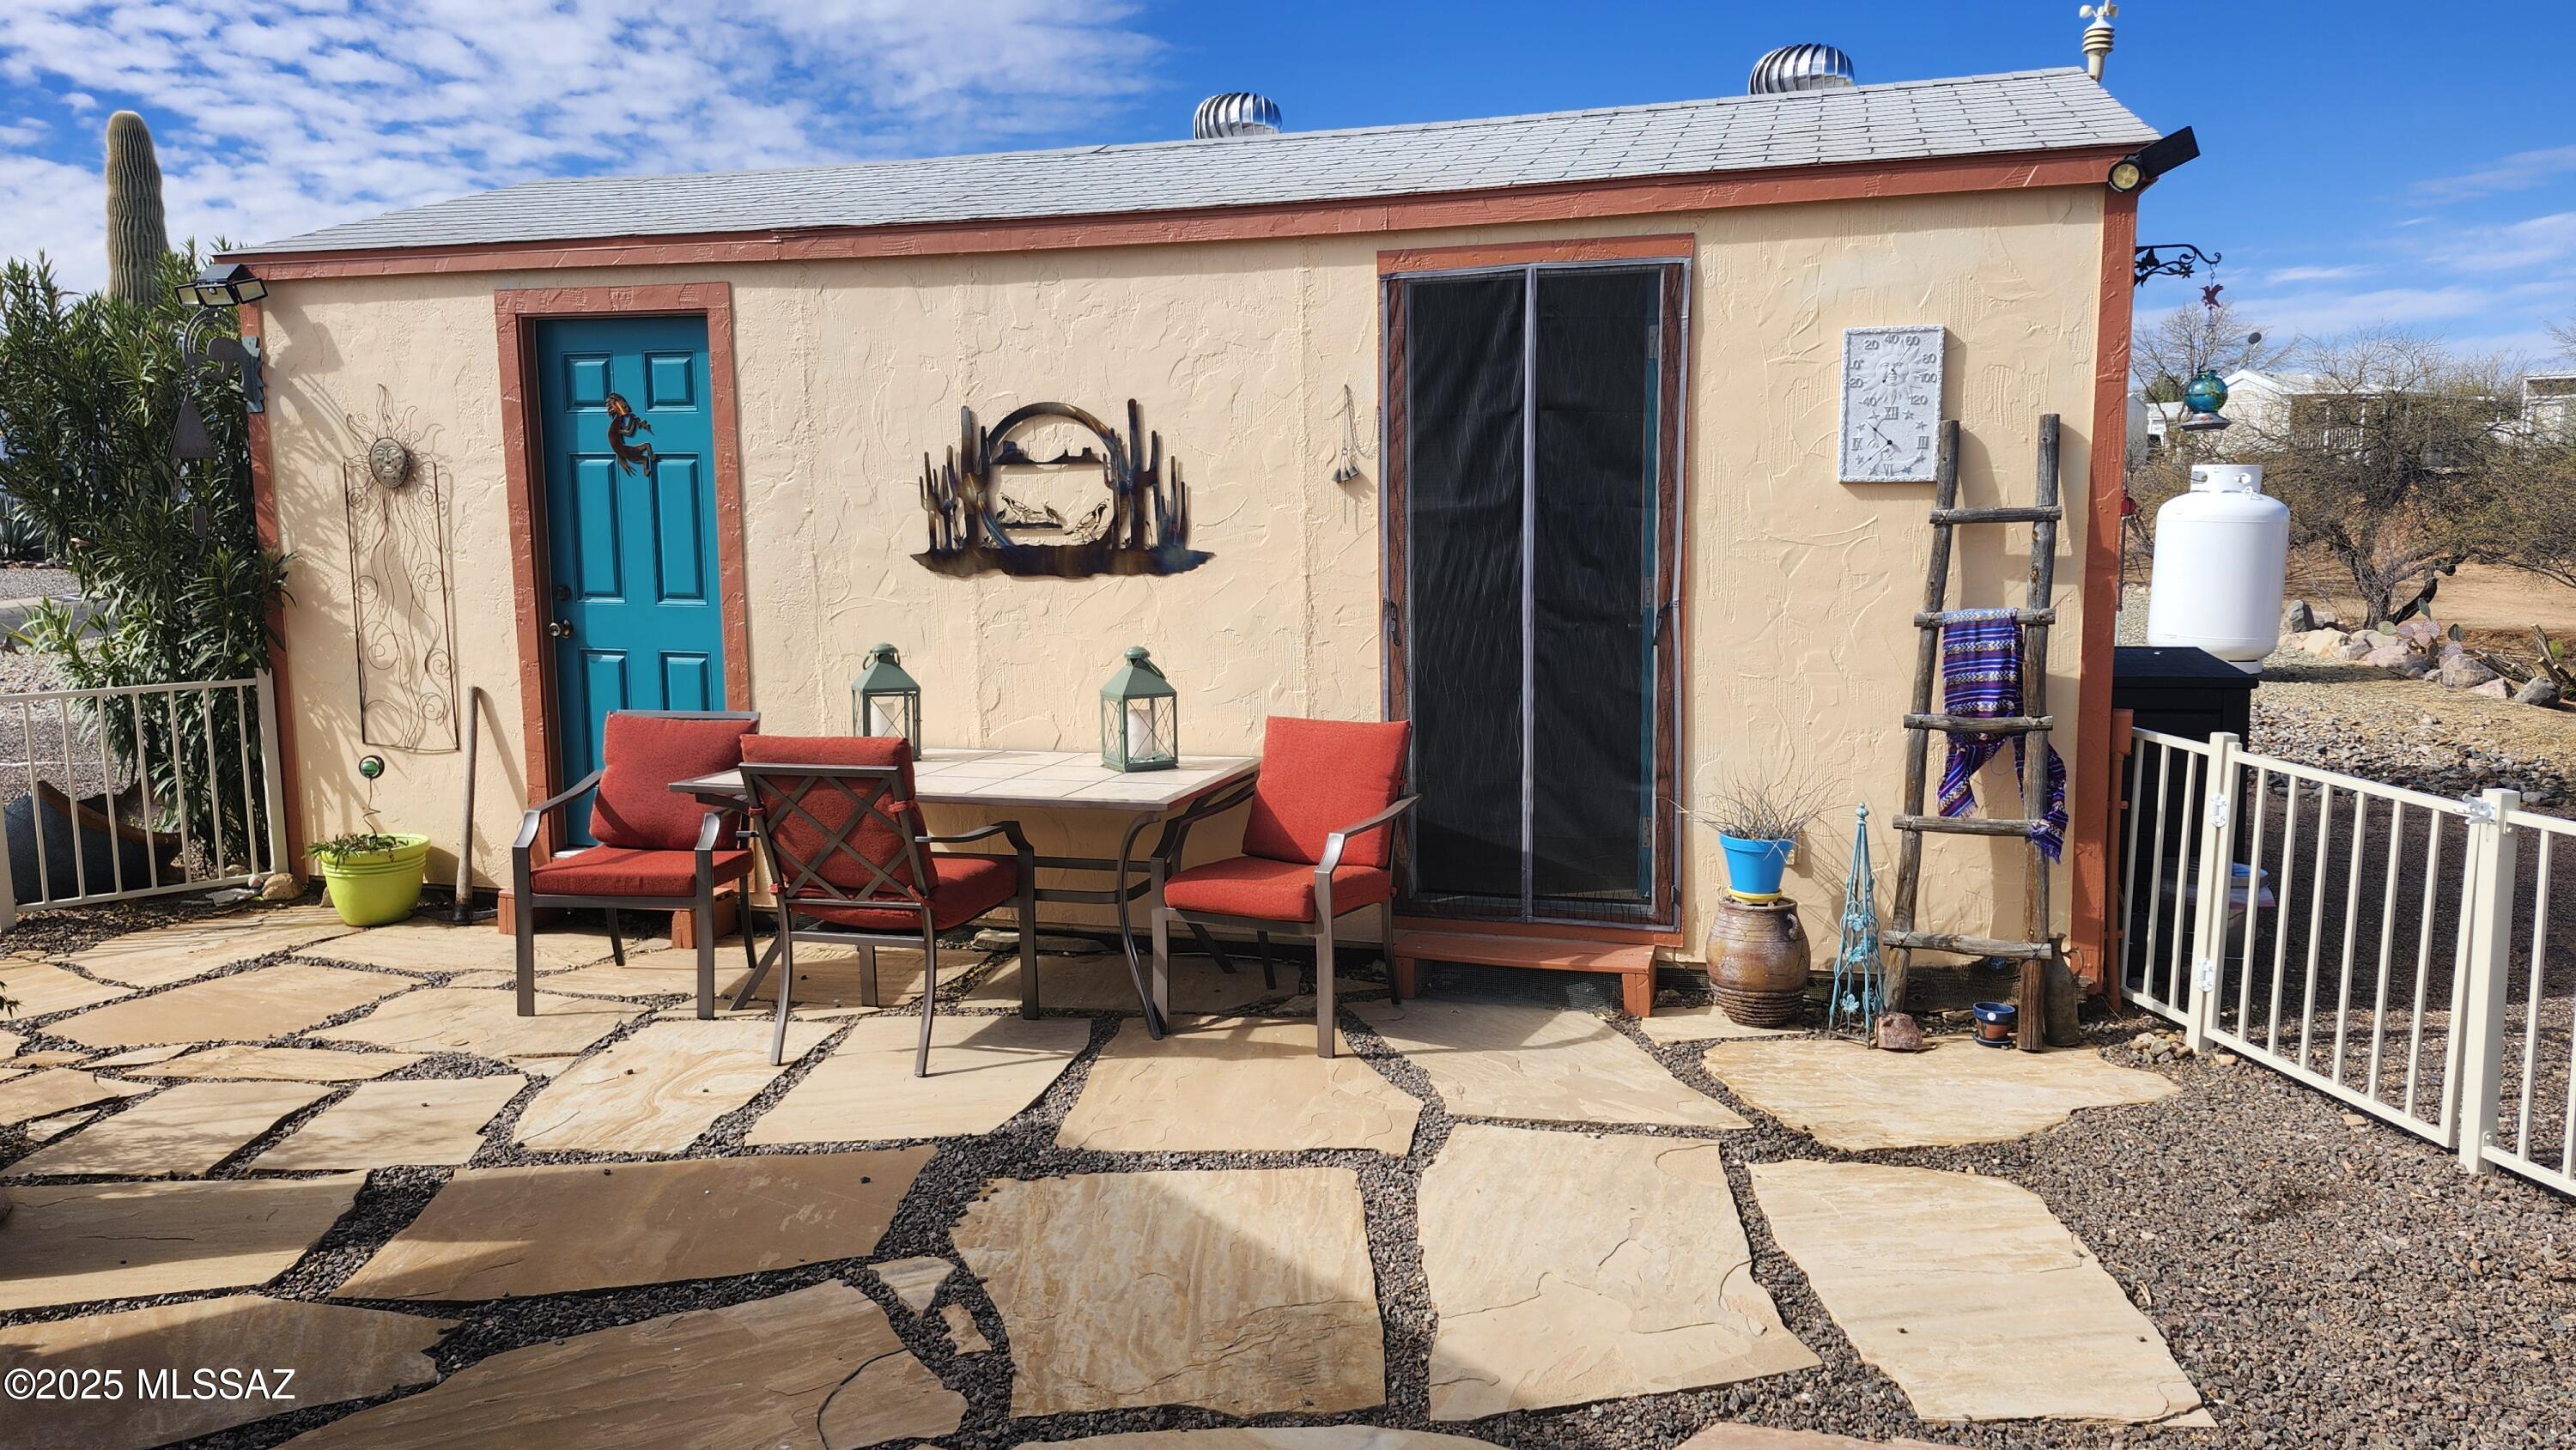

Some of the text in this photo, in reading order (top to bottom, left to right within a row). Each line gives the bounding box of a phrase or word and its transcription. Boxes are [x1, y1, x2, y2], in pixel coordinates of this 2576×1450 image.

[1884, 334, 1899, 344] 40
[1905, 336, 1920, 346] 60
[1864, 340, 1880, 350] 20
